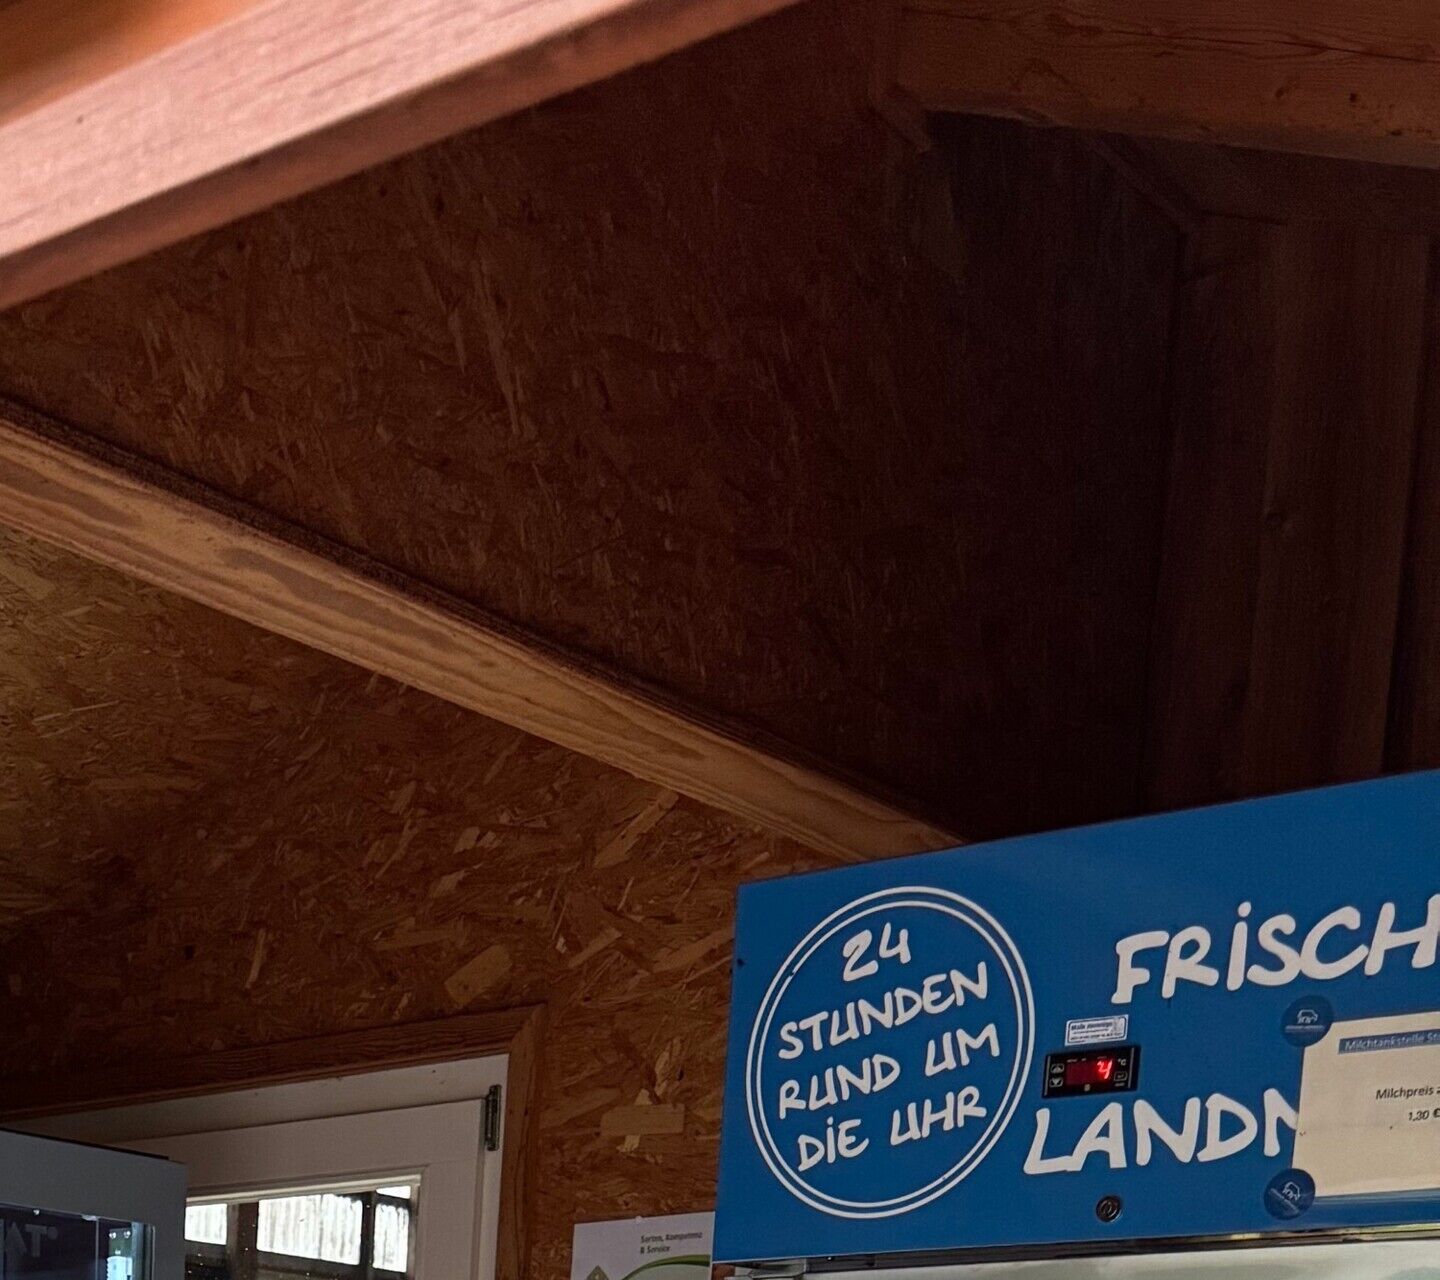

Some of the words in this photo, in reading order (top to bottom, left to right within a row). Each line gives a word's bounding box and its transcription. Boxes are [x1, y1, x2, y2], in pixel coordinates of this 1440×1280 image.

[843, 923, 911, 982] 24
[779, 962, 988, 1060] STUNDEN
[779, 1054, 901, 1120] RUND
[925, 1023, 1000, 1077] UM
[1375, 1085, 1435, 1099] Milchpreis
[891, 1086, 987, 1146] UHR
